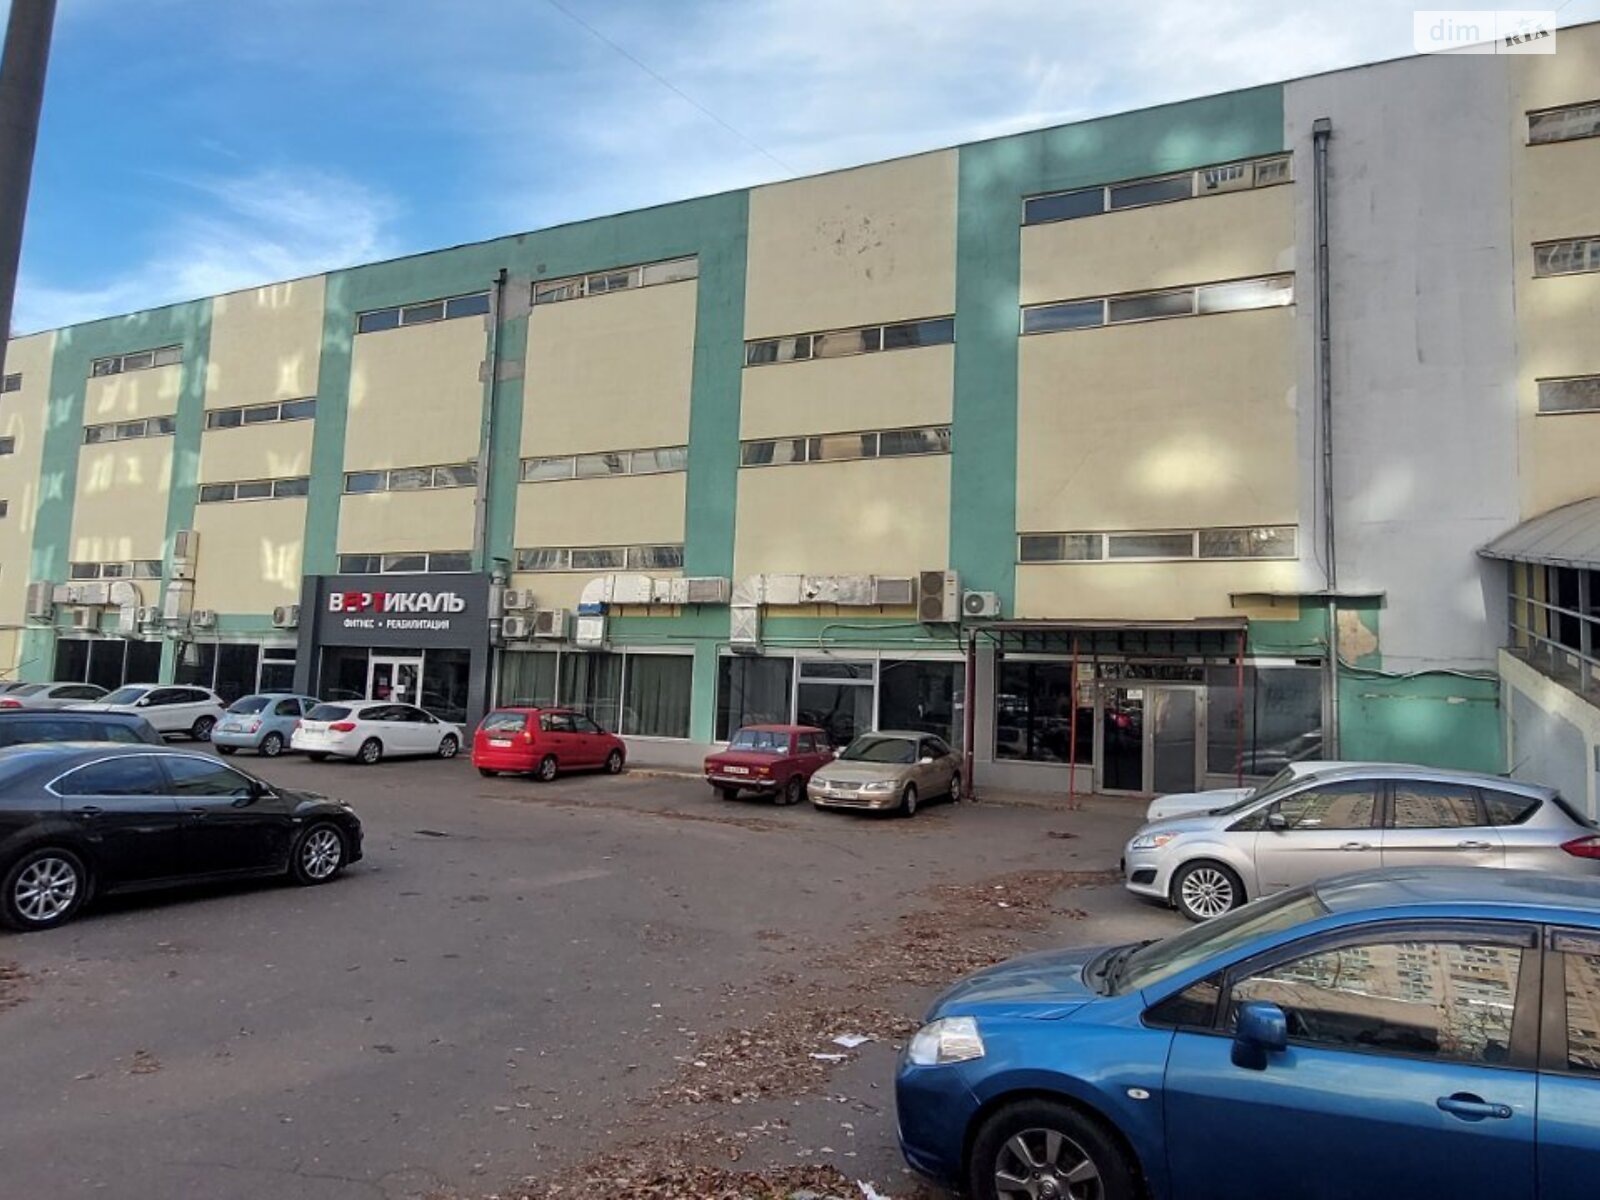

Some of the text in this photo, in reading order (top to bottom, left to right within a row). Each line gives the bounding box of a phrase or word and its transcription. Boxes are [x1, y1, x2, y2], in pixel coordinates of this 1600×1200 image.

[329, 591, 466, 613] ВЕРТИКАЛЬ
[343, 618, 450, 631] ФИТНЕС РЕАБИЛИТАЦИЯ
